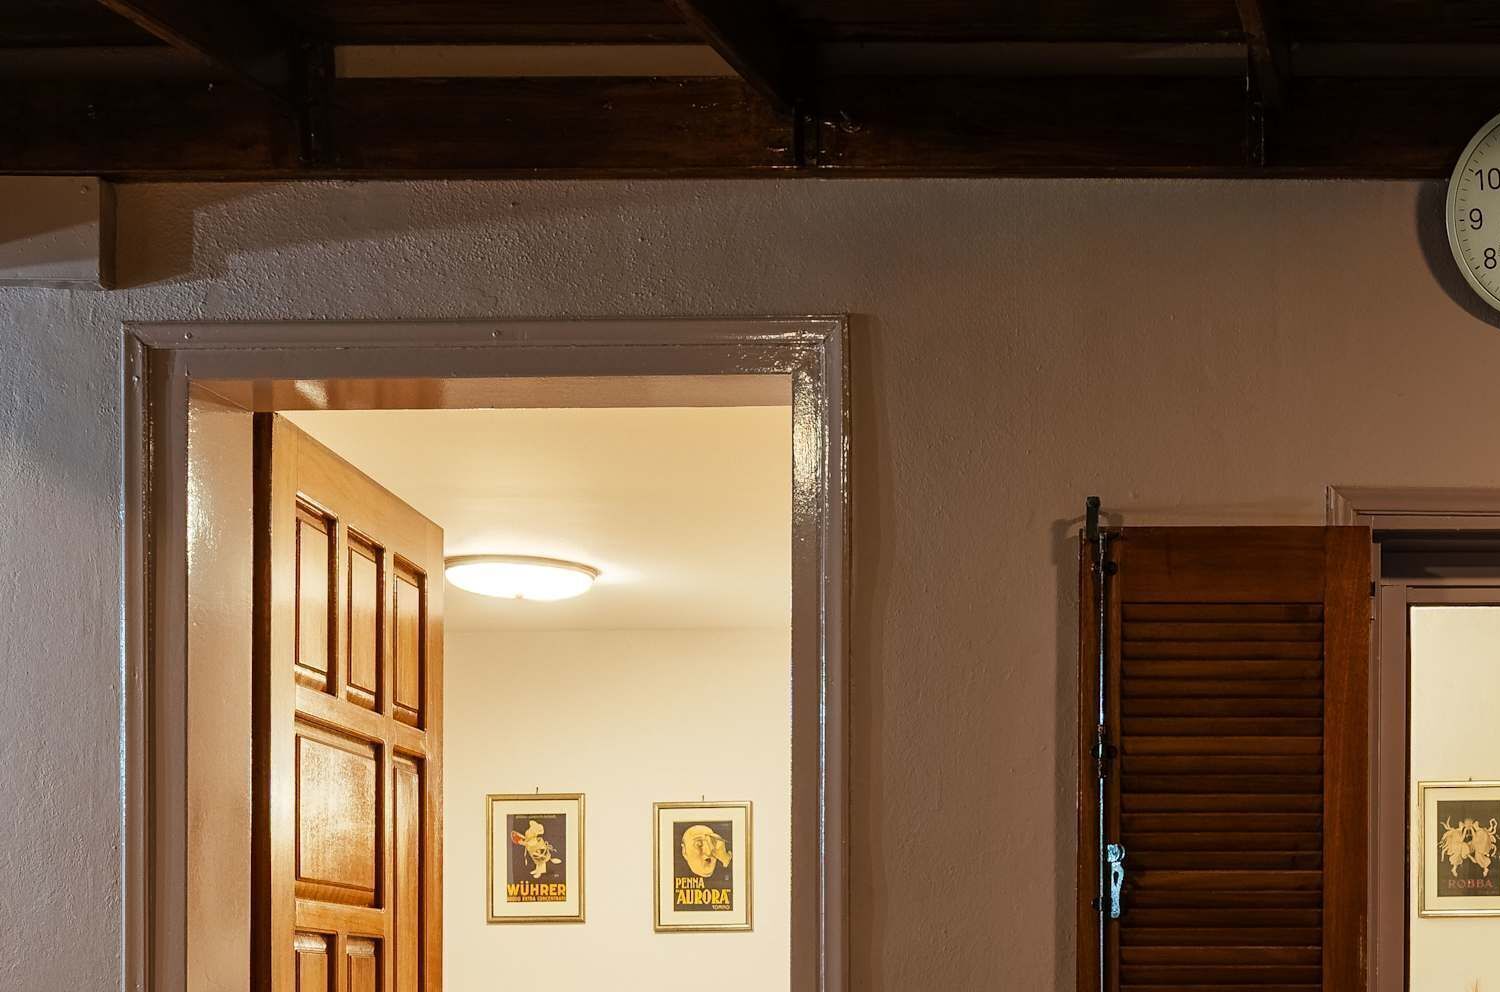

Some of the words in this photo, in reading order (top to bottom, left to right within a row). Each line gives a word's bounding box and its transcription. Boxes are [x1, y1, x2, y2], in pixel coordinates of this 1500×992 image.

[1469, 207, 1483, 230] 9
[1483, 247, 1498, 270] 8
[507, 881, 566, 895] WÜHRER
[676, 877, 705, 889] PENNA
[1448, 879, 1494, 888] ROBBA
